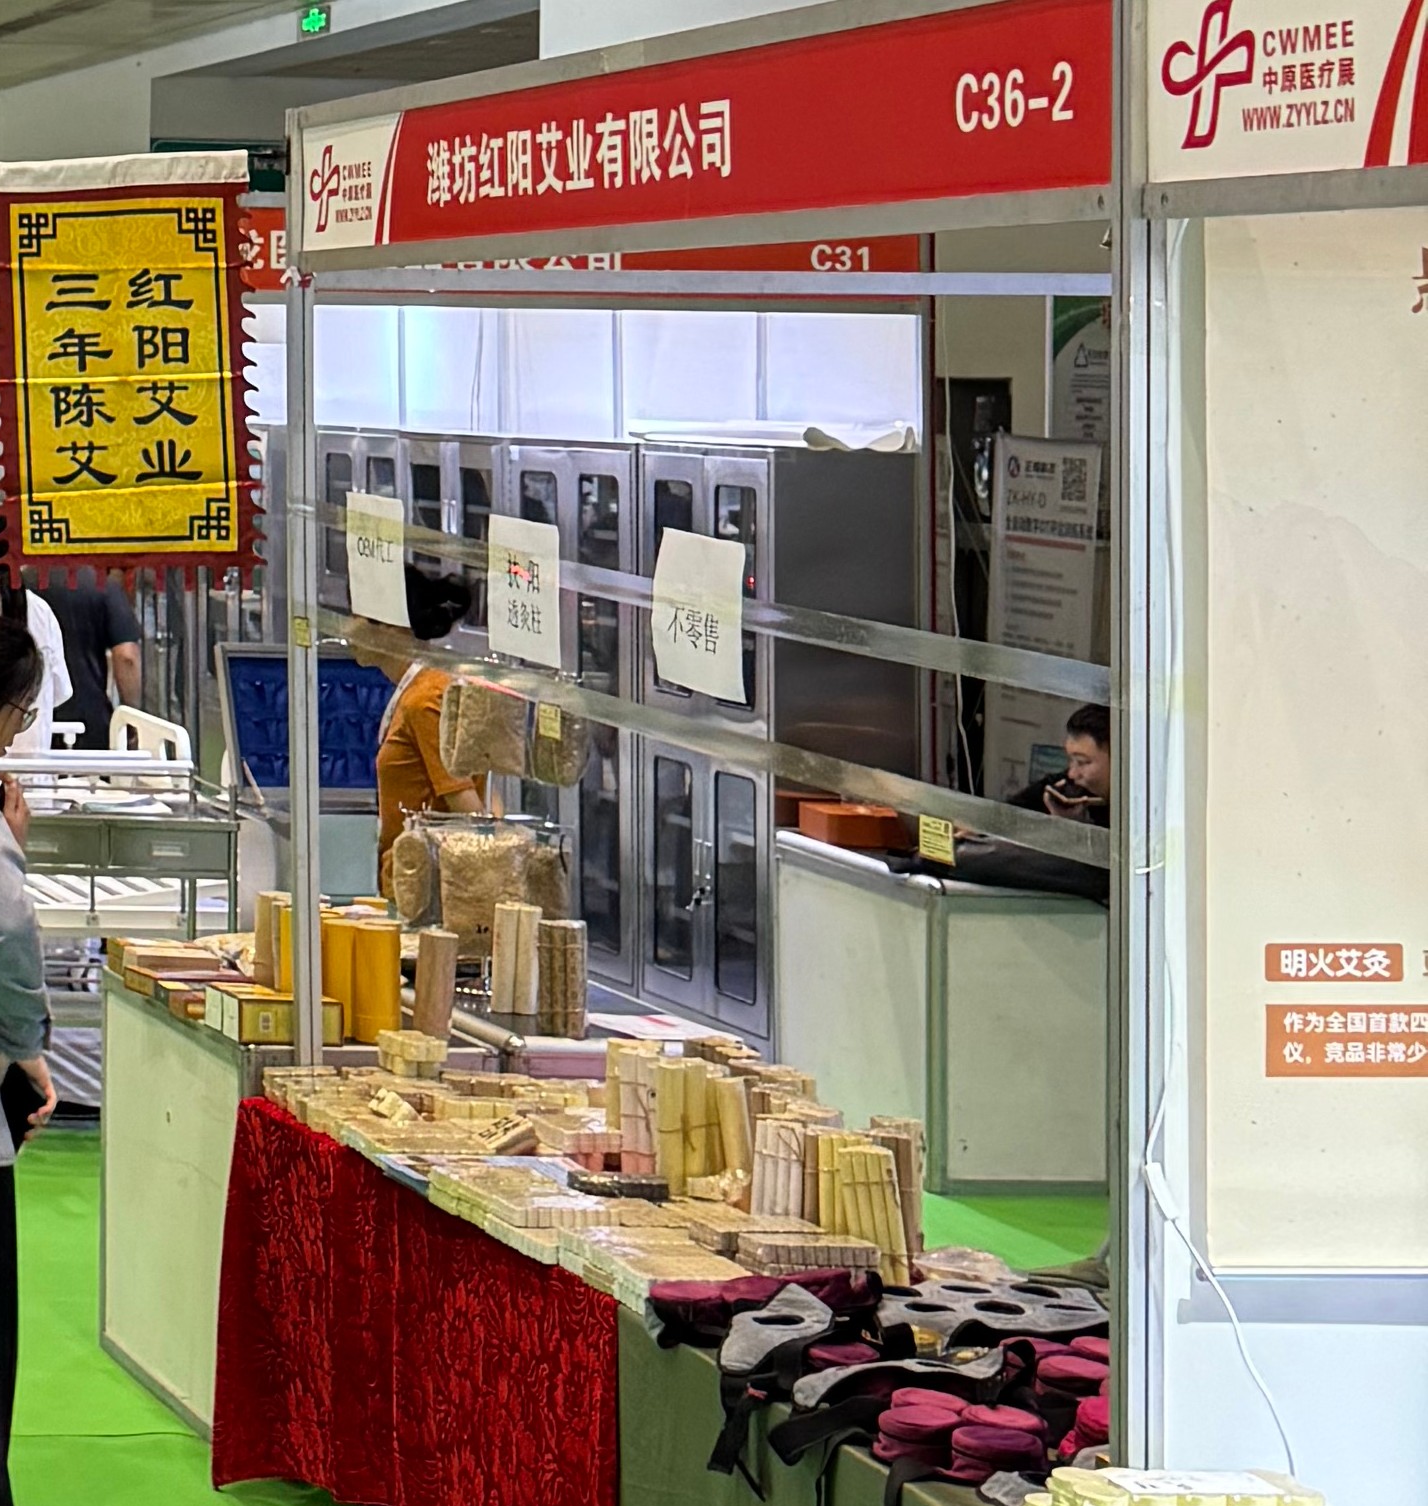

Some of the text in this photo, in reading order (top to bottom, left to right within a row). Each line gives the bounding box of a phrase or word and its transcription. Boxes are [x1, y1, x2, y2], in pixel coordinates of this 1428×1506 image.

[1262, 20, 1355, 57] CWMEE
[1262, 57, 1355, 95] 中原医疗展
[954, 60, 1075, 134] C36-2
[1241, 97, 1356, 132] WWW.ZYYLZ.CN
[342, 161, 372, 181] CWMEE
[425, 97, 733, 207] 潍坊红阳艾业有限公司
[810, 245, 871, 272] C31
[45, 273, 118, 486] 三年陈艾
[125, 268, 204, 485] 红阳艾业
[666, 605, 721, 656] 不零售
[1279, 948, 1392, 979] 明火艾灸
